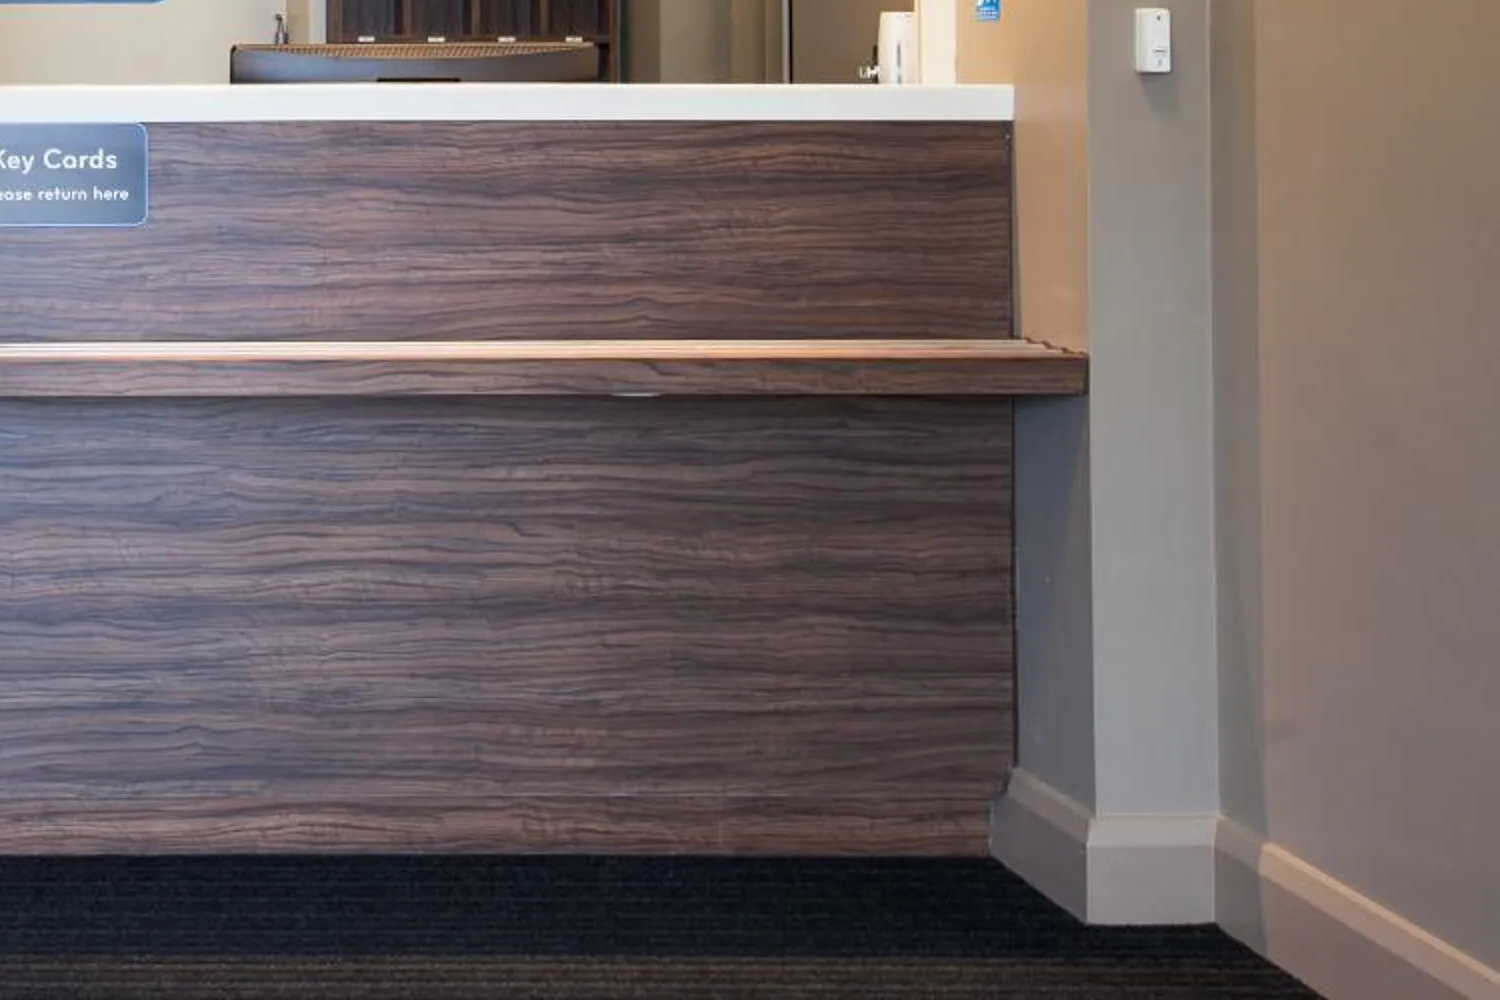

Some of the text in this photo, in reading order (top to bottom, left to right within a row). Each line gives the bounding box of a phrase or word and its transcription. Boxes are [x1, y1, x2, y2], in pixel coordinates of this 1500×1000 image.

[43, 147, 118, 170] Cards
[37, 187, 88, 201] return
[93, 186, 129, 201] here
